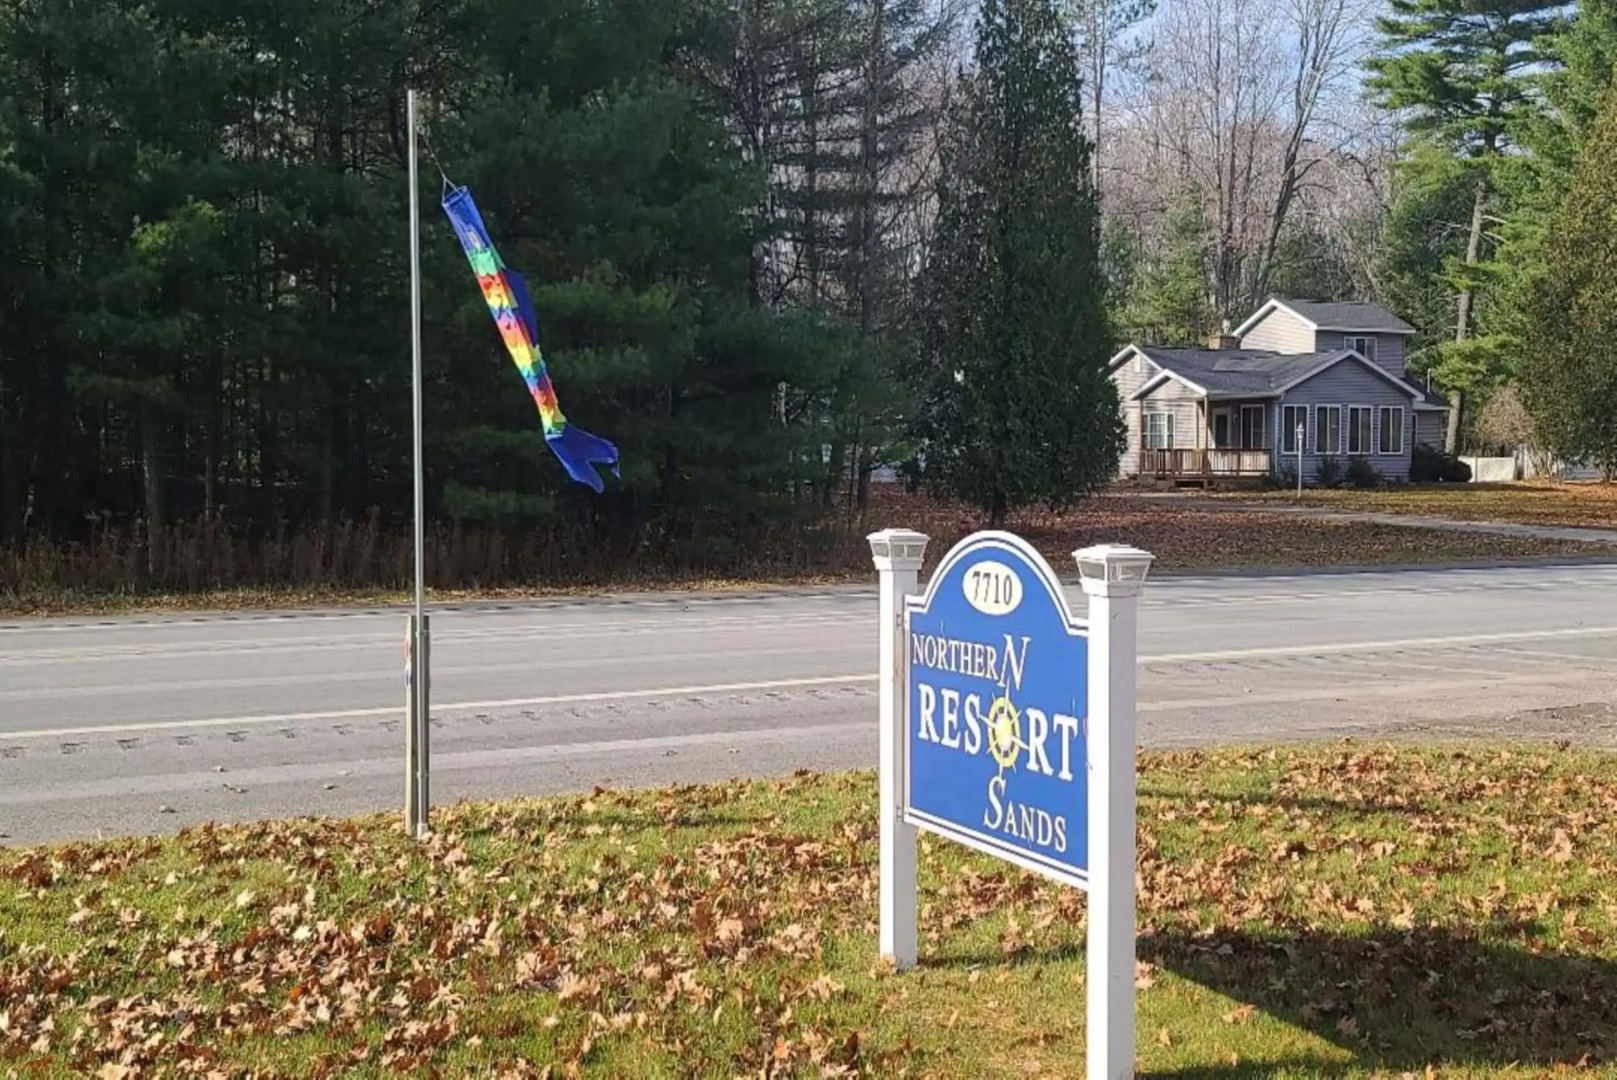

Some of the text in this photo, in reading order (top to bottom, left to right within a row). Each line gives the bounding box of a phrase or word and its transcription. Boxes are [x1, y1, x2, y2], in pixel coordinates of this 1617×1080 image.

[972, 571, 1013, 605] 7710
[912, 633, 1031, 691] NORTHERN
[984, 775, 1067, 853] SANDS
